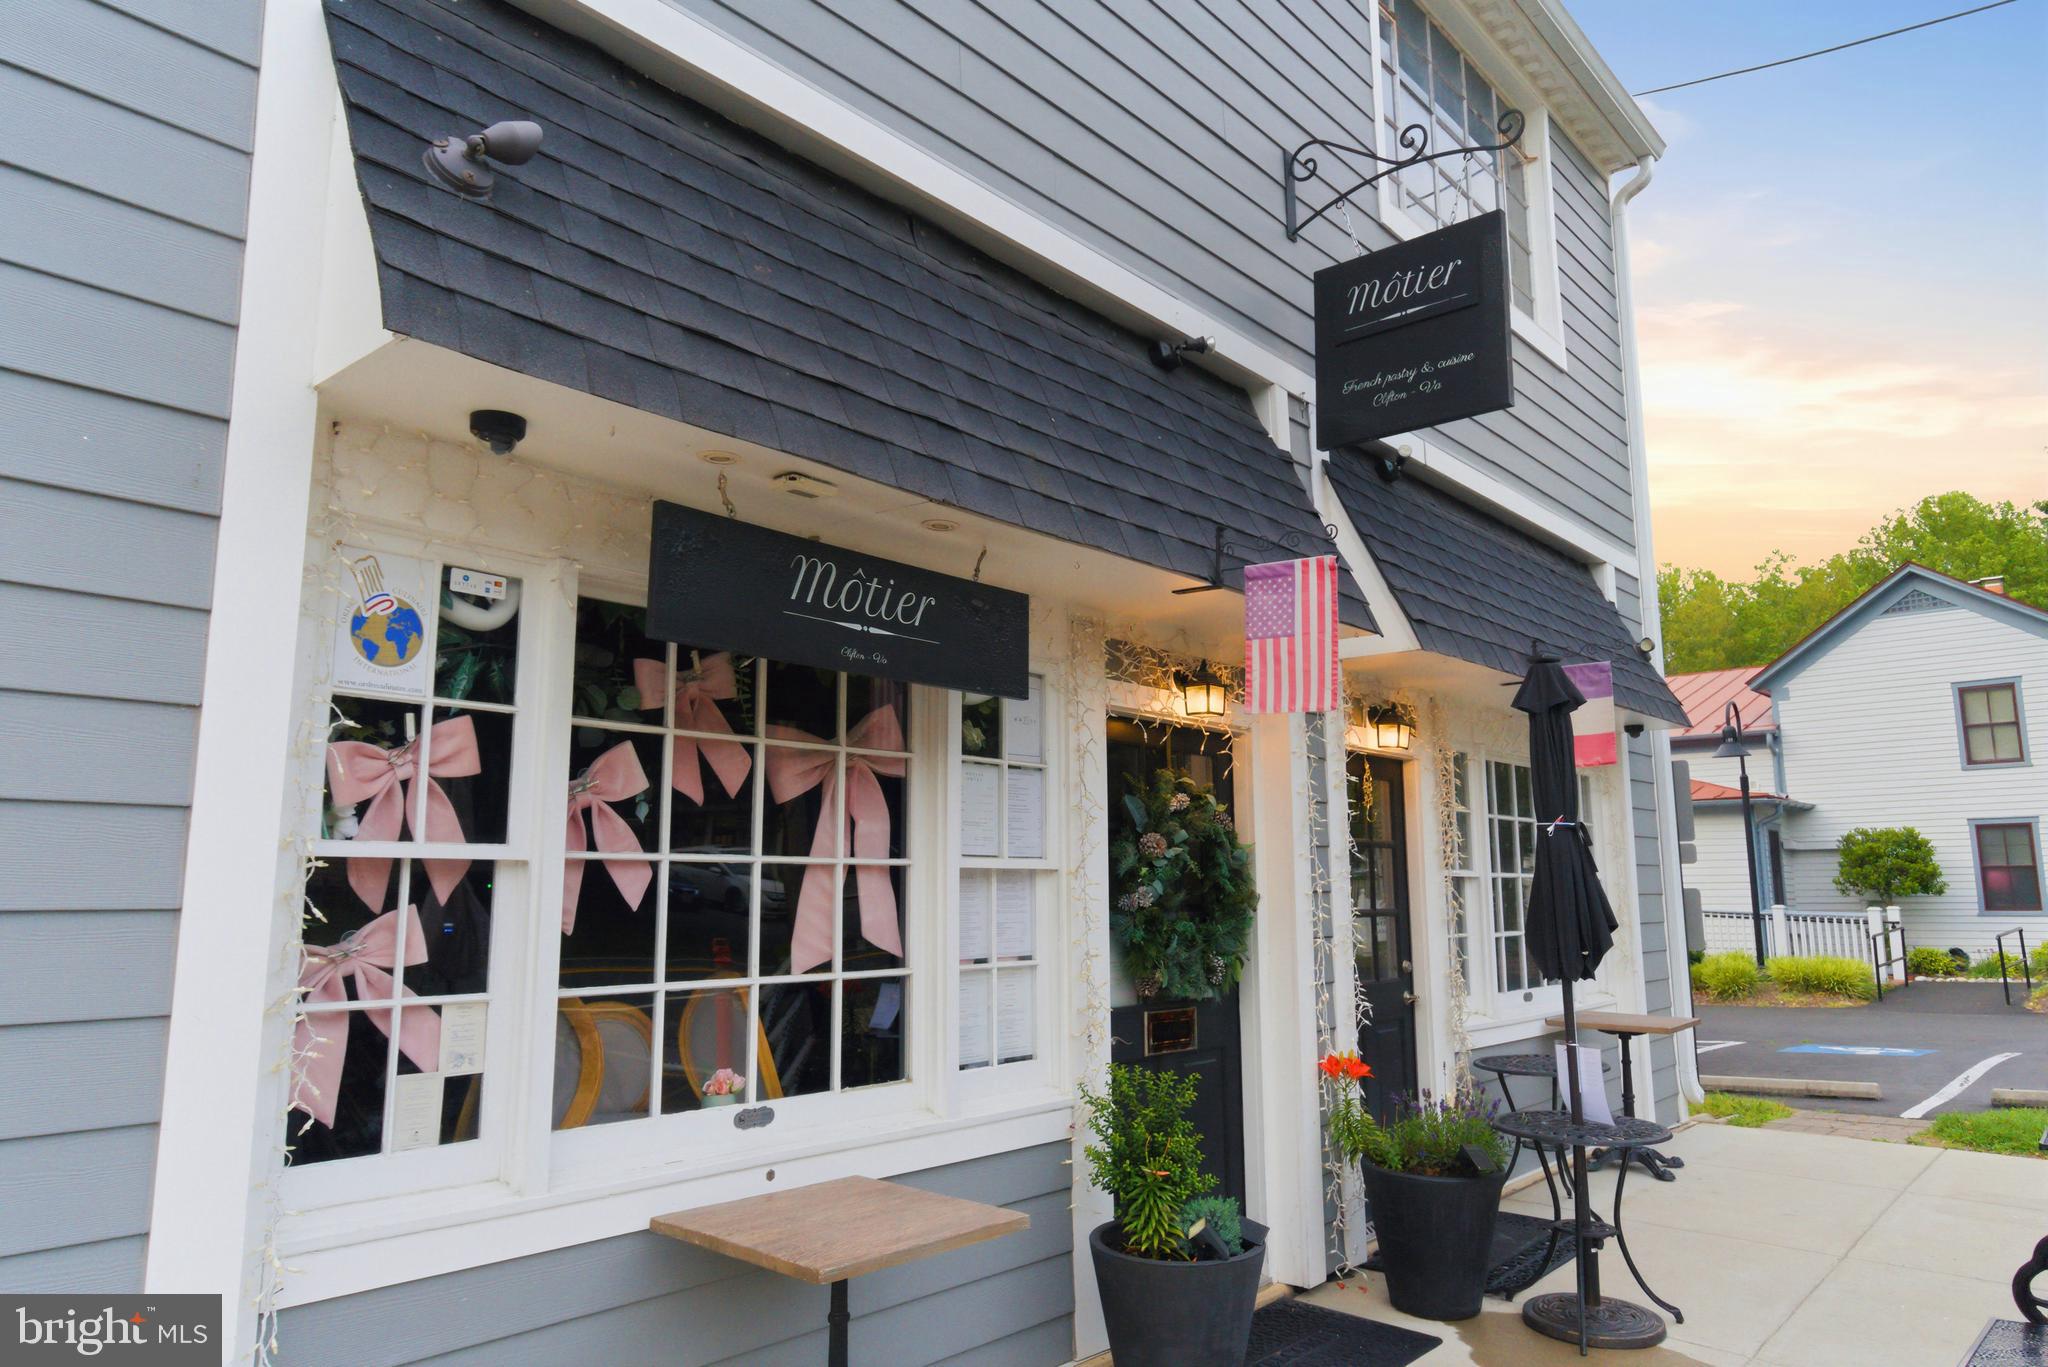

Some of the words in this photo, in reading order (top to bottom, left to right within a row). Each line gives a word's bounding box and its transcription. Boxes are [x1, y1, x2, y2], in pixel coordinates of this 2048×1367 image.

[1347, 258, 1462, 315] Môtier
[1342, 371, 1382, 395] French
[1382, 367, 1417, 388] pastry
[1420, 361, 1434, 374] &
[1437, 352, 1475, 369] cuisine
[1373, 390, 1407, 407] Clifton
[1419, 380, 1442, 393] Va
[790, 554, 936, 627] Môtier
